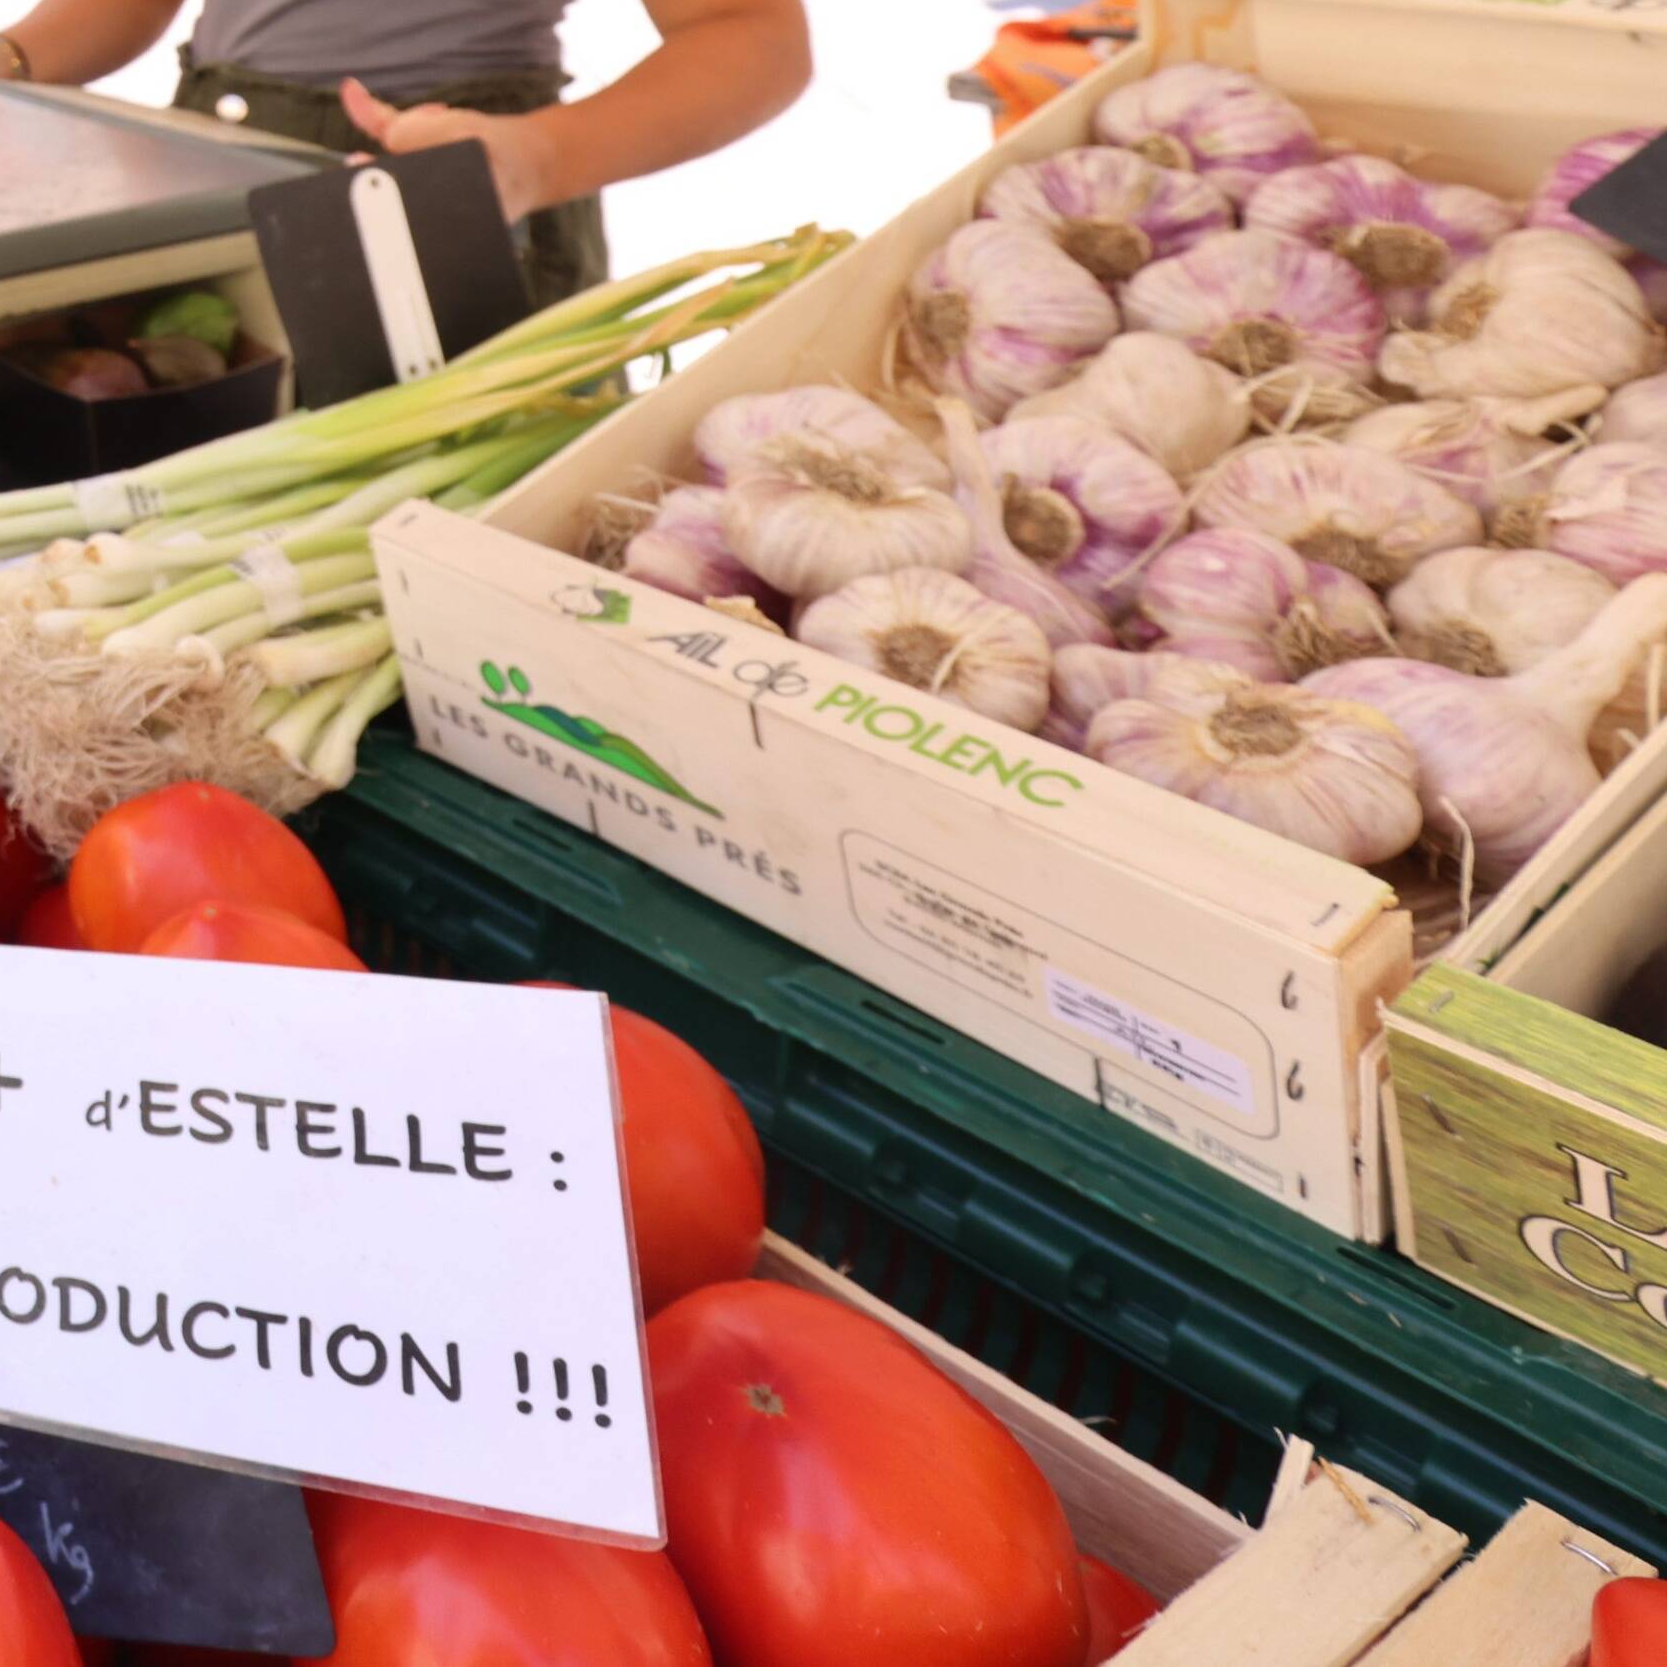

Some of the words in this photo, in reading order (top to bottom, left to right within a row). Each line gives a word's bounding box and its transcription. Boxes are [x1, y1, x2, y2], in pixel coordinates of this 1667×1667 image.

[430, 694, 489, 739] LES
[503, 732, 679, 833] GRANDS
[694, 825, 803, 896] PRÉS
[813, 682, 1085, 808] PIOLENC
[84, 1079, 514, 1182] d'ESTELLE
[513, 1350, 613, 1429] !!!
